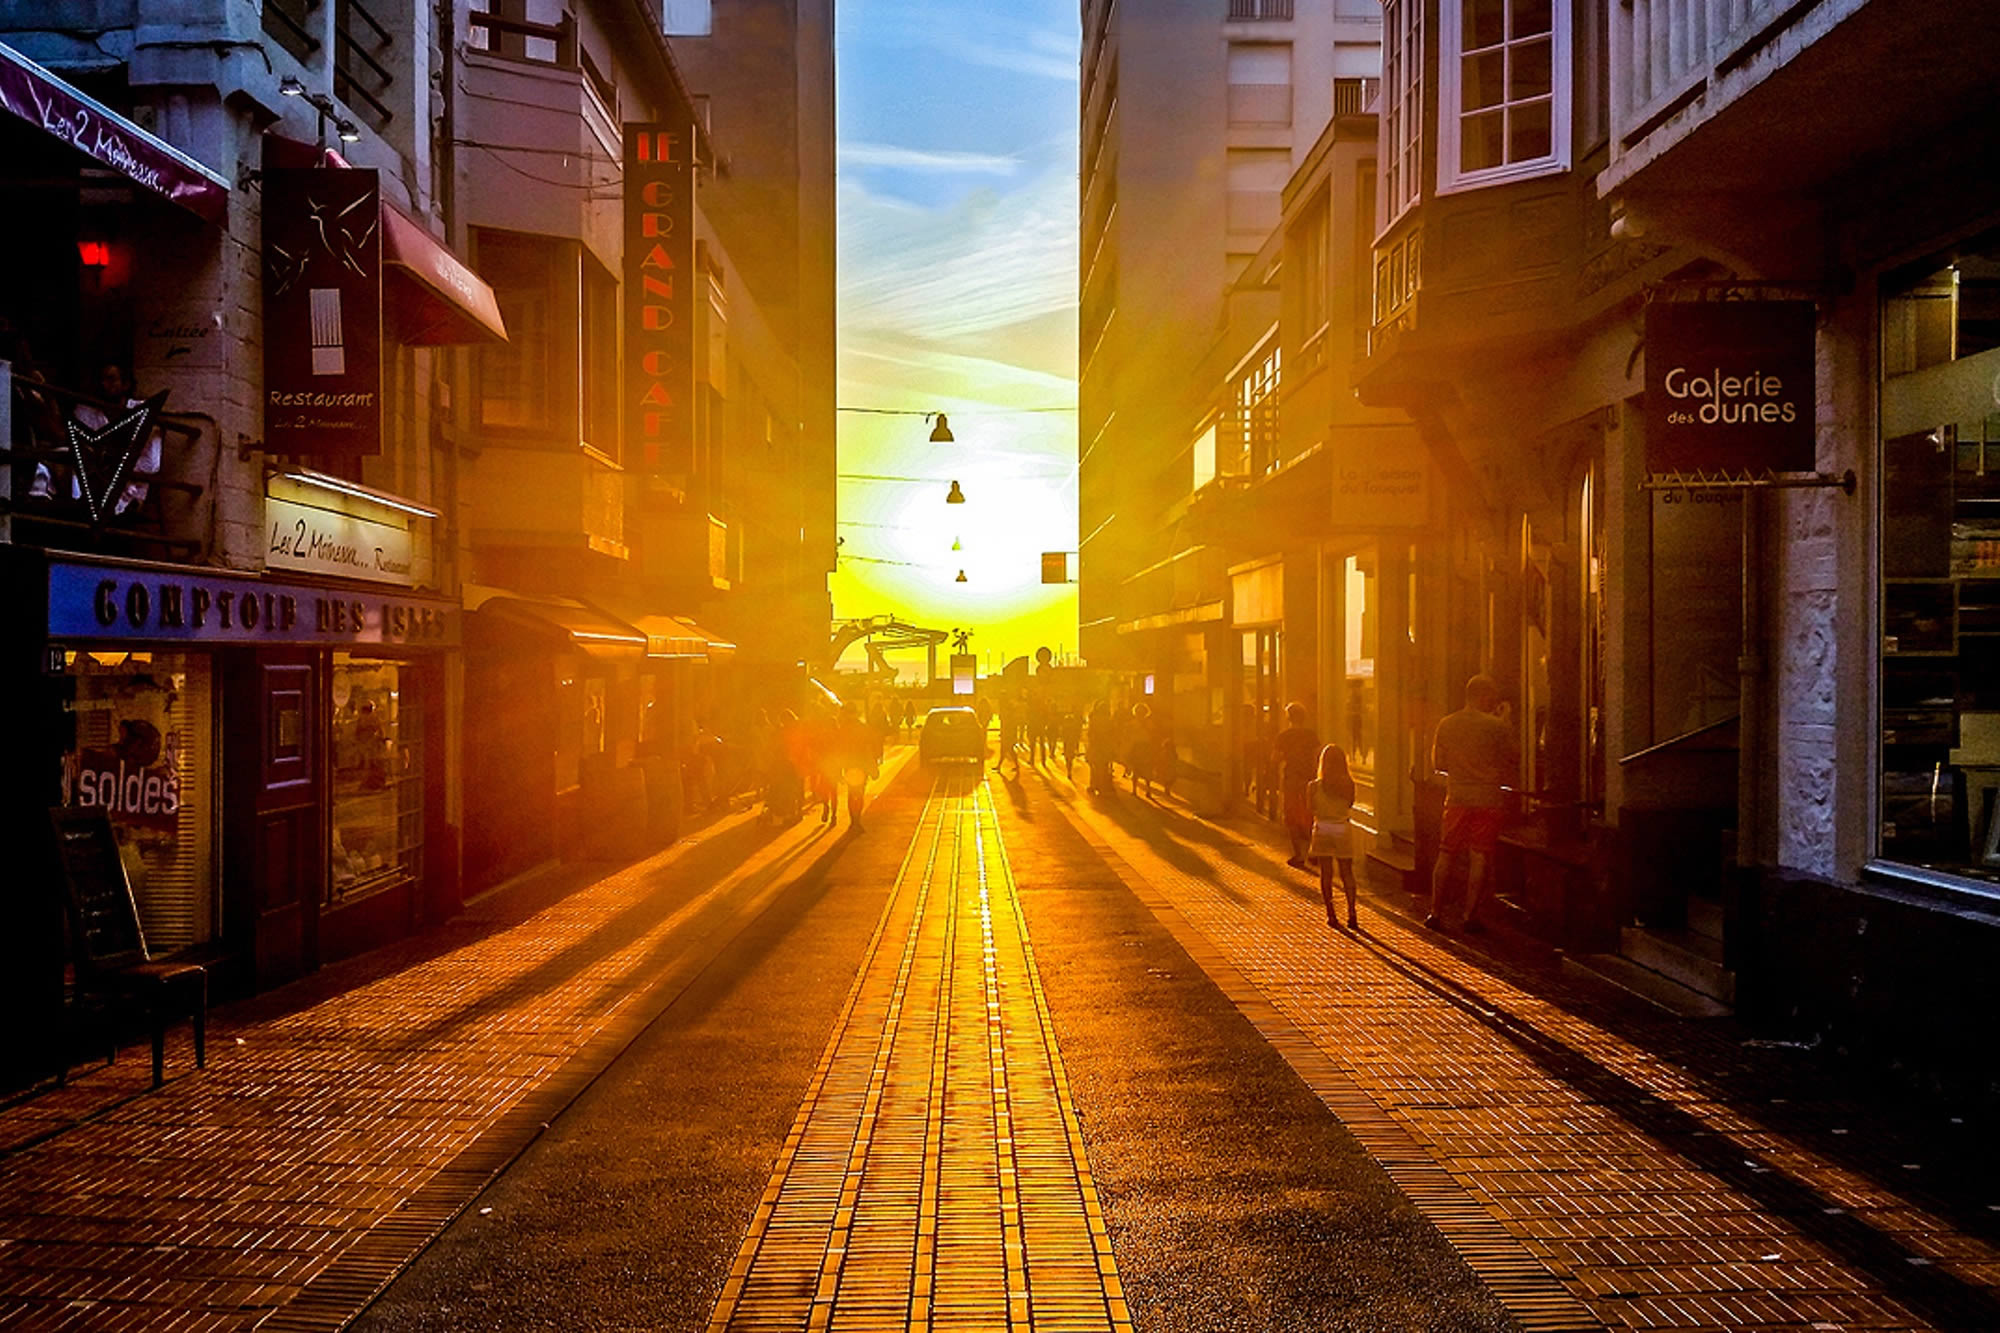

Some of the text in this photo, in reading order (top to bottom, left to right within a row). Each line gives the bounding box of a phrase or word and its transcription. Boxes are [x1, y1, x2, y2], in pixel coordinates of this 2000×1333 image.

[74, 109, 92, 153] 2
[638, 131, 680, 162] LE
[639, 181, 676, 331] GRAND
[270, 390, 374, 407] Restaurant
[1665, 367, 1783, 399] Galerie
[1667, 392, 1796, 424] des dunes
[1663, 487, 1744, 508] du Touque
[270, 522, 291, 554] Les
[294, 518, 306, 558] 2
[93, 578, 447, 641] COMPTOIR DES ISLES
[79, 759, 178, 815] soldes
